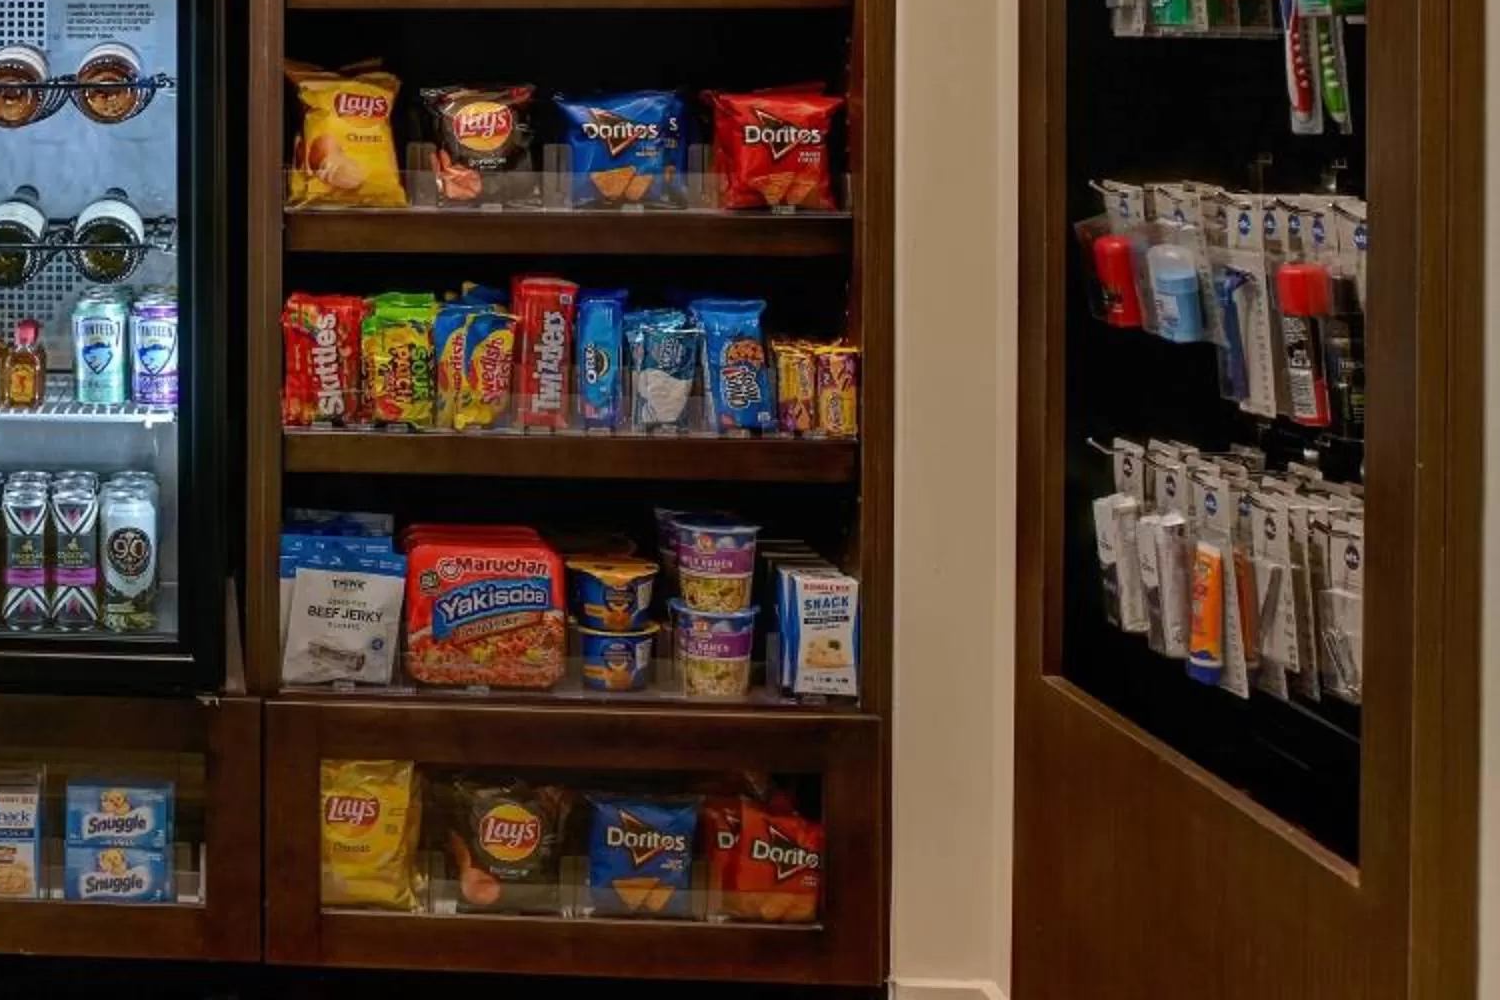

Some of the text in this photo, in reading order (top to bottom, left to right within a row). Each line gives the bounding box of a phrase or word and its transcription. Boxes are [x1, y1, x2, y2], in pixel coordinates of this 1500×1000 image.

[338, 93, 388, 119] Lay's
[458, 109, 513, 138] Lay's
[582, 121, 660, 139] Doritos
[744, 125, 822, 144] Doritos
[311, 312, 344, 415] Skittles
[531, 311, 567, 413] Twizzlers
[455, 557, 549, 576] Maruchan
[307, 605, 386, 624] BEEF JERKY
[442, 584, 548, 624] Yakisoba
[803, 596, 850, 611] SNACK
[326, 796, 380, 826] Lay's
[87, 815, 147, 836] Snuggle
[484, 818, 537, 848] Lay's
[607, 826, 686, 851] Doritos
[752, 839, 820, 868] Dorito
[85, 875, 145, 896] Snuggle
